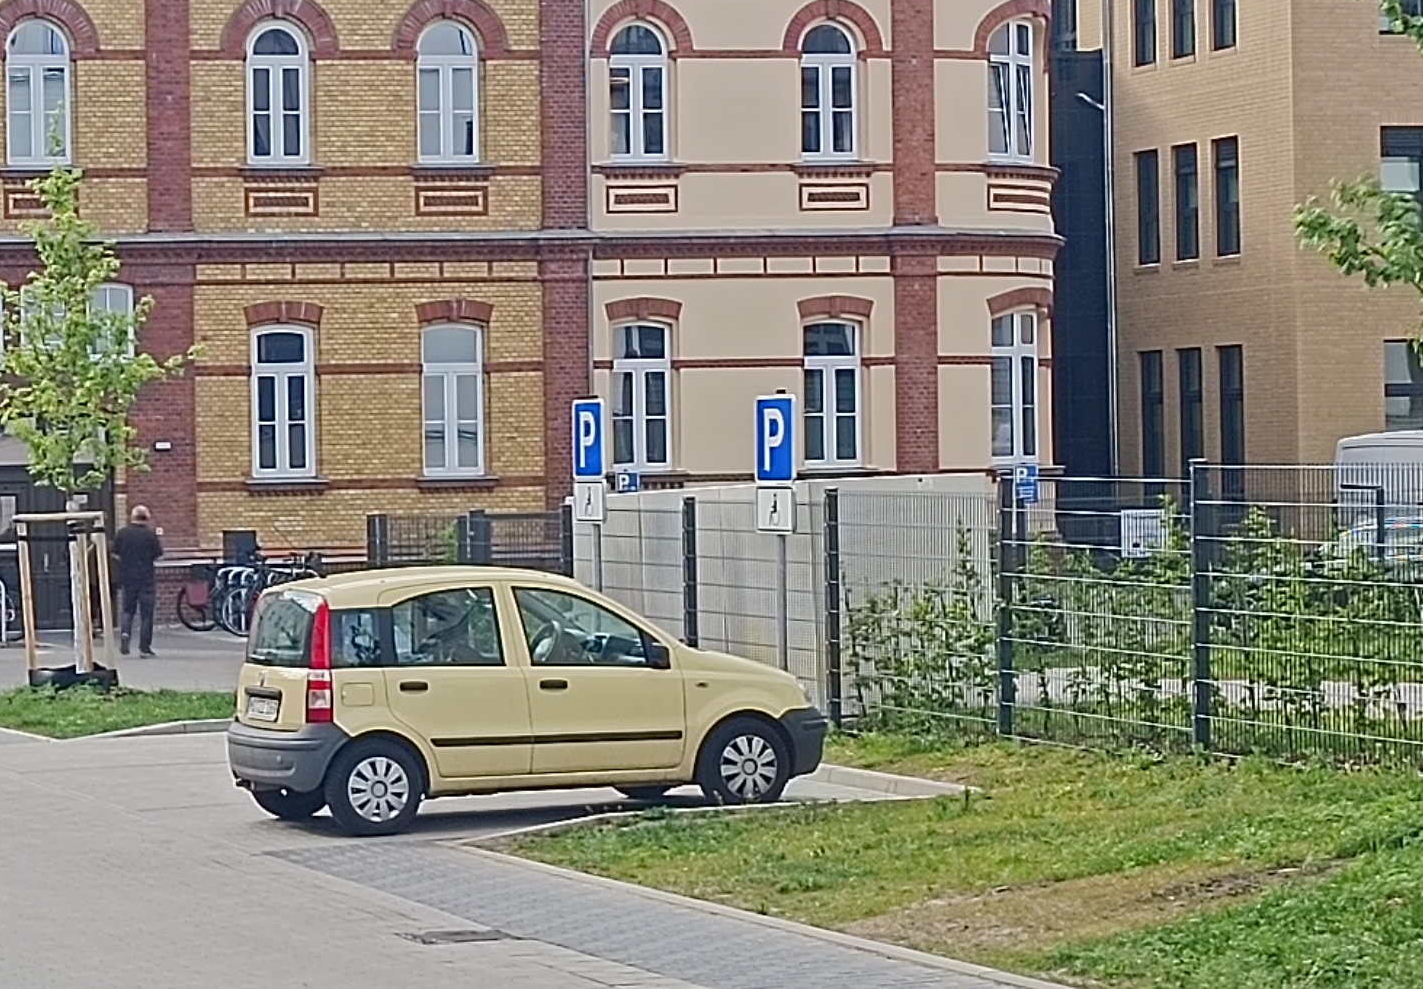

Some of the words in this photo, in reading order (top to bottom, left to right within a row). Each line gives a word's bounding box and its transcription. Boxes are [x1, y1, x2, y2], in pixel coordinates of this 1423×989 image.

[578, 410, 596, 468] P
[763, 408, 785, 472] P
[618, 474, 630, 490] P
[1016, 468, 1028, 483] P
